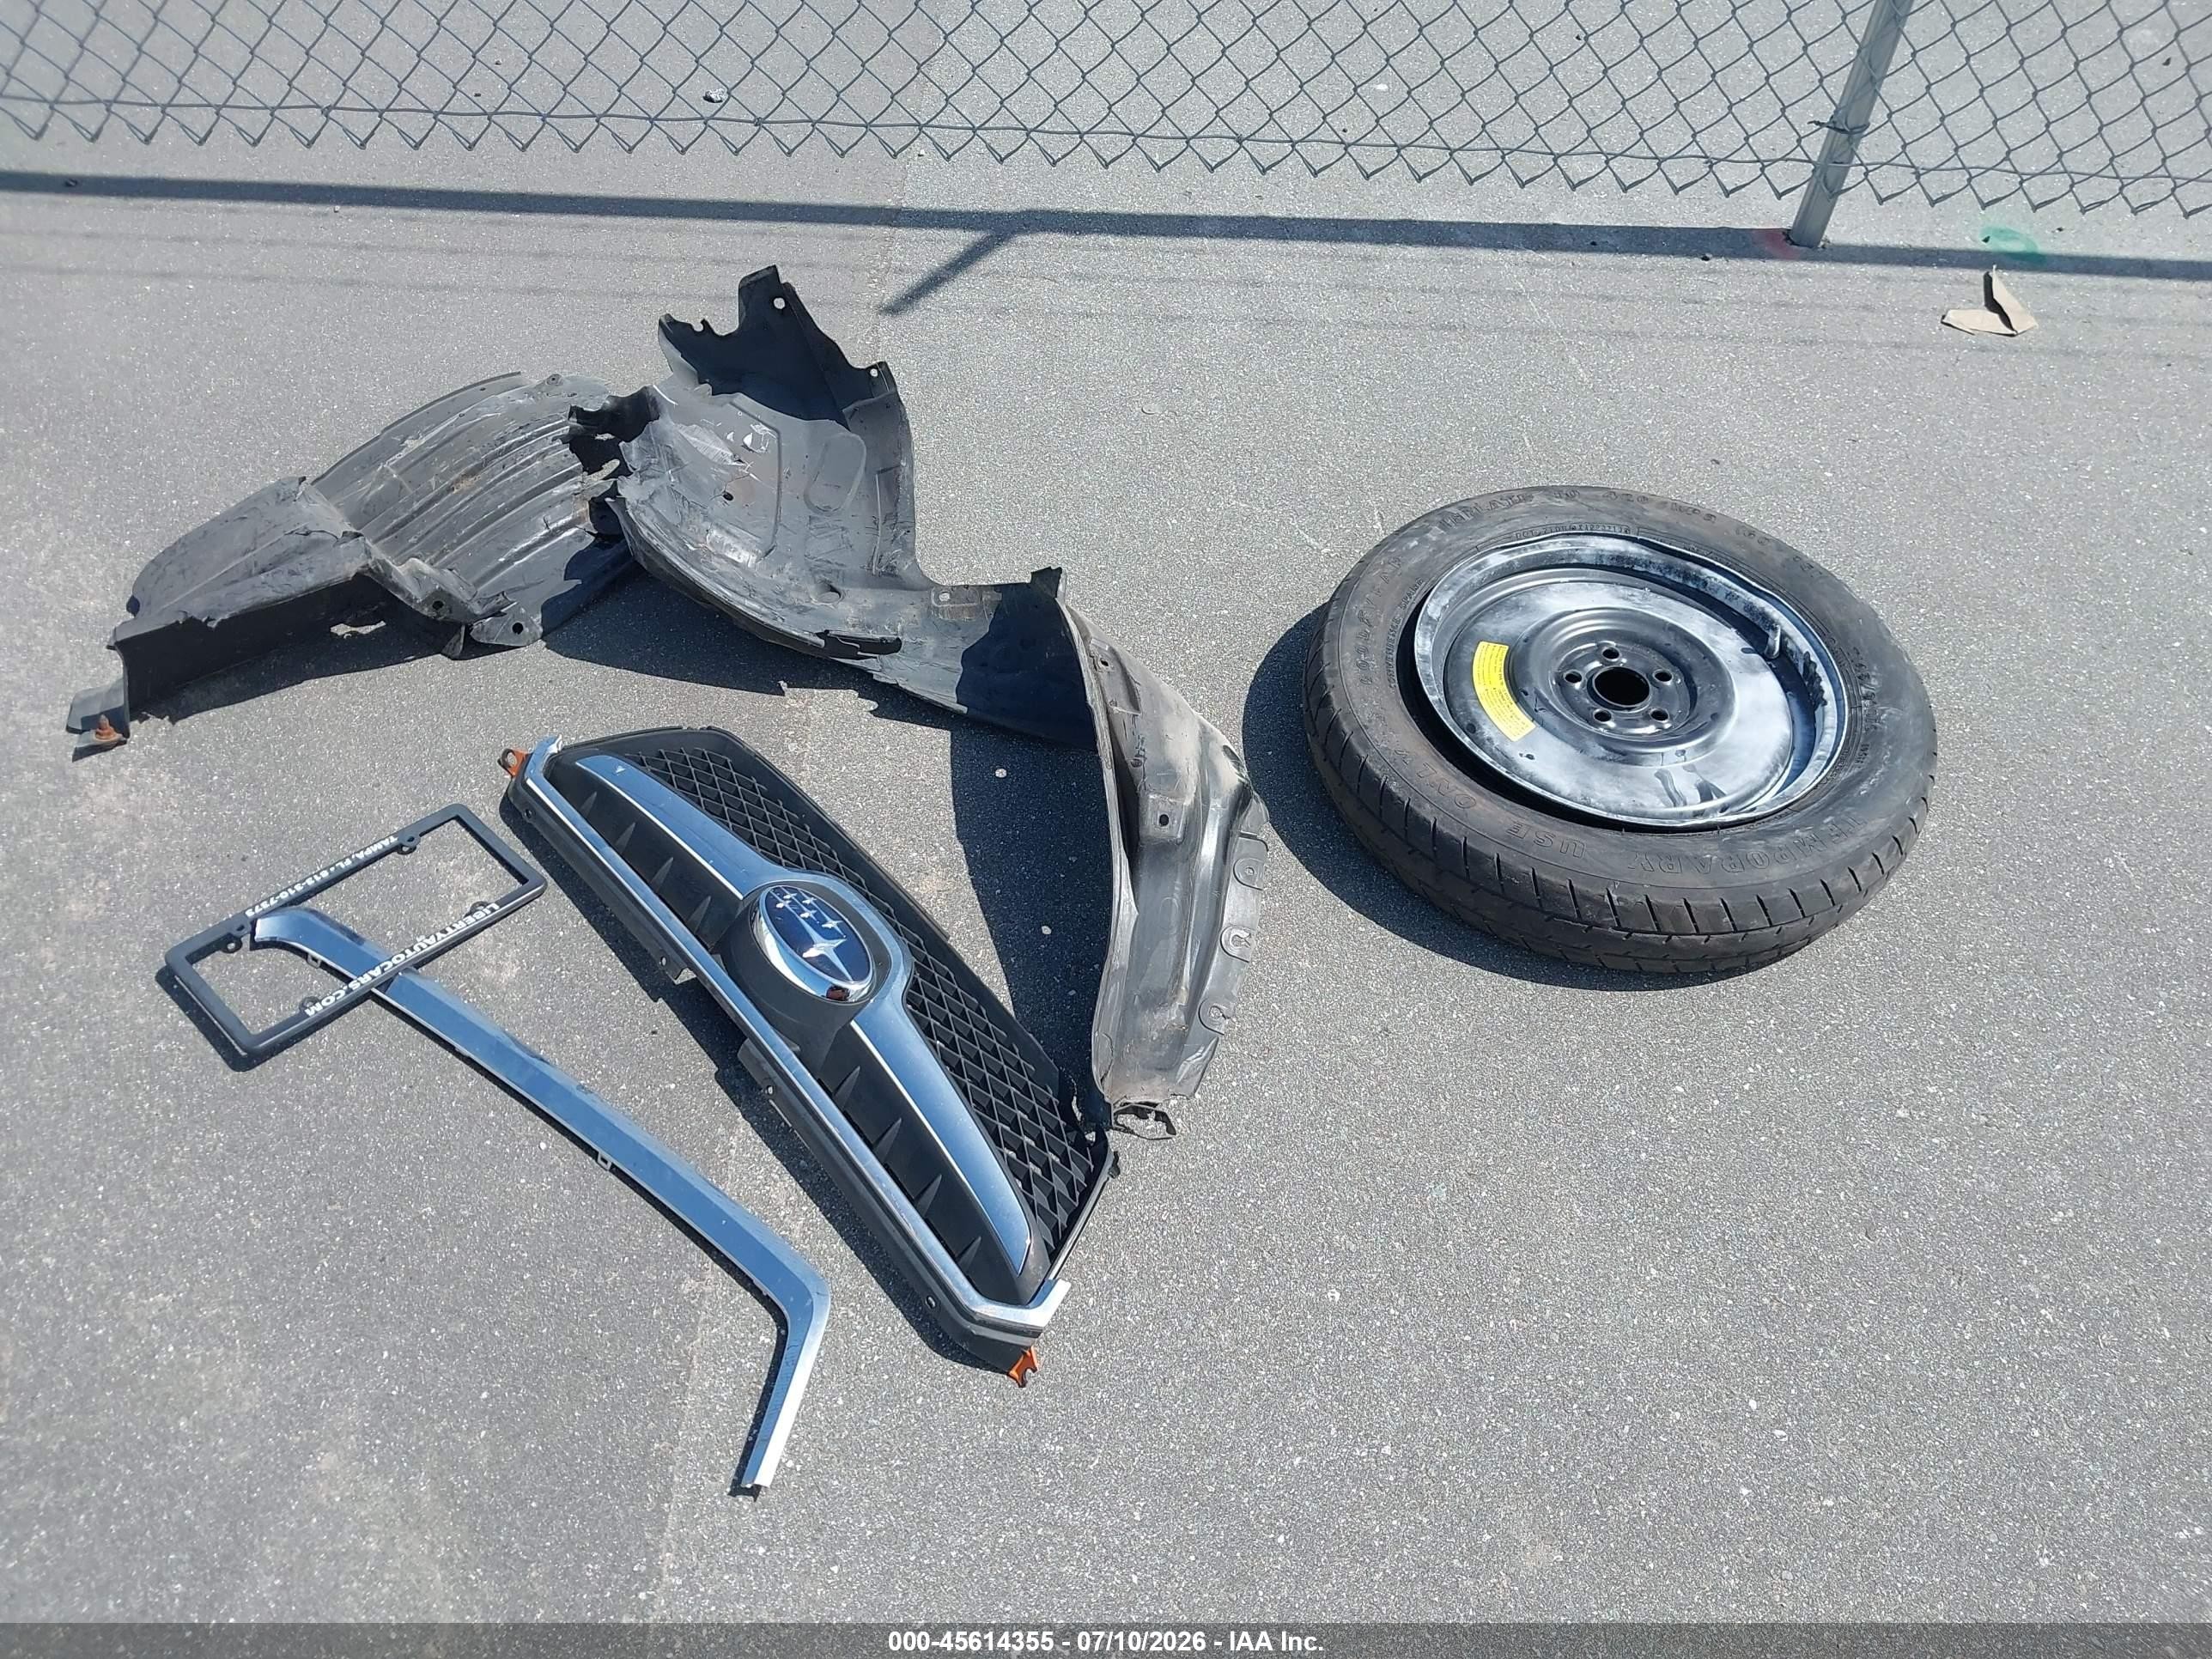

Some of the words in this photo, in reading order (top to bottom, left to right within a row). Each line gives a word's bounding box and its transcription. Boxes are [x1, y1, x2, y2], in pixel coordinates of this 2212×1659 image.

[1394, 747, 1477, 810] ONLY
[1504, 820, 1585, 860] USE
[1627, 817, 1868, 874] TEMPORARY
[304, 901, 502, 1017] LIBERTYAUTOCARS.COM
